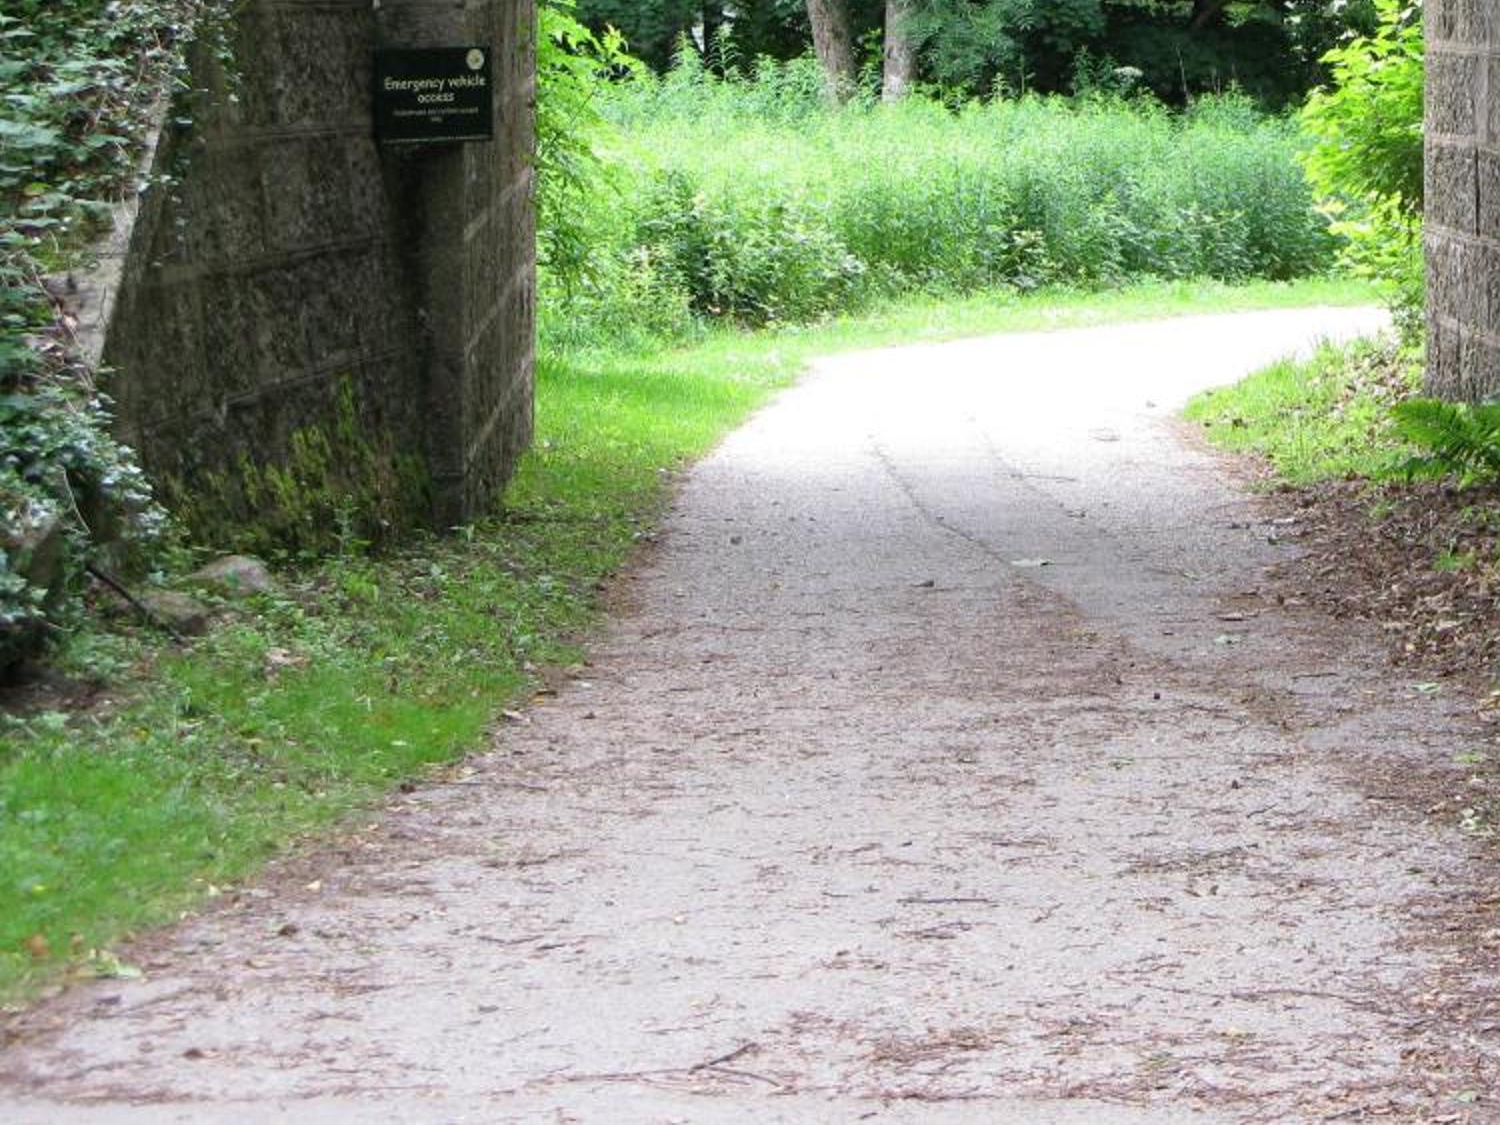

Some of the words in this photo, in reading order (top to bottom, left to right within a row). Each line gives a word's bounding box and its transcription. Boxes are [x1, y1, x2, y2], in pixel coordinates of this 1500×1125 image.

[384, 76, 445, 92] Emergency
[448, 74, 486, 88] vehicle
[417, 93, 455, 104] access
